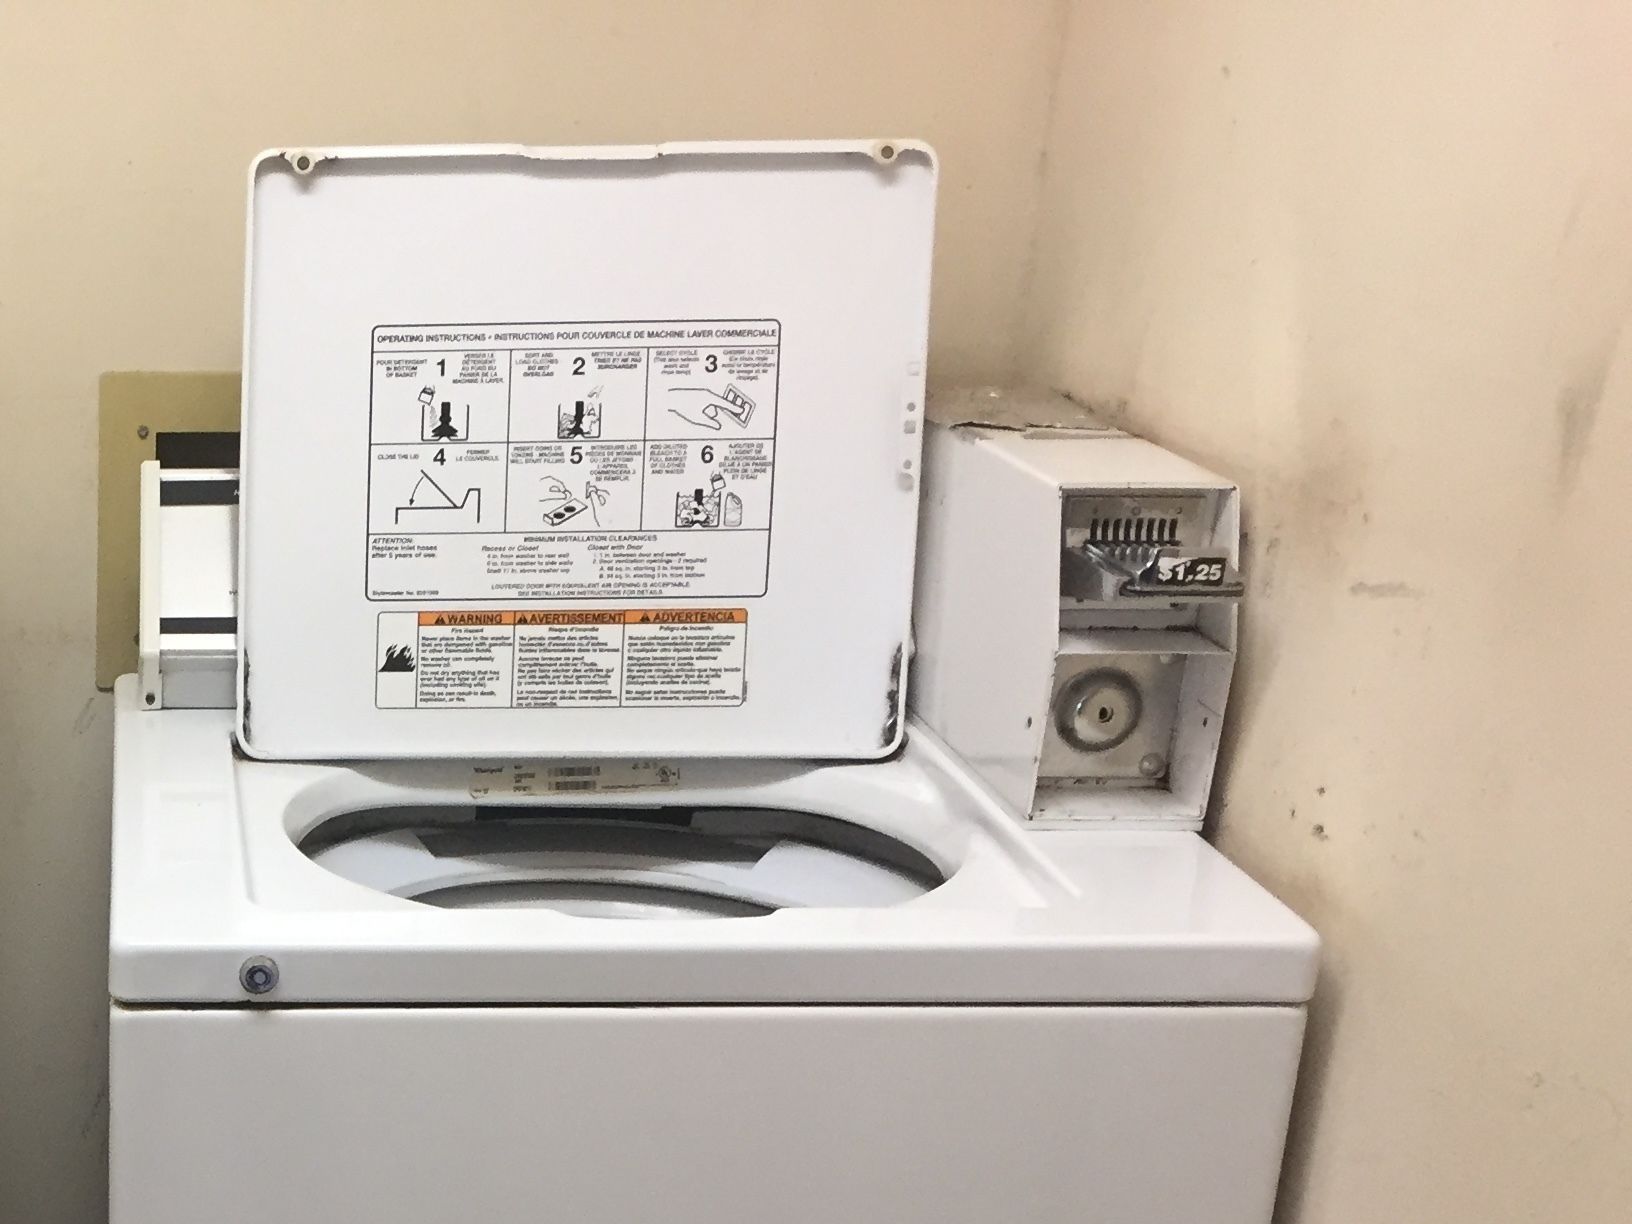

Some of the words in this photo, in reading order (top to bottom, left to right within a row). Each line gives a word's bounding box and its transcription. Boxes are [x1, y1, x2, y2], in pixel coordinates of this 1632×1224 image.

[377, 335, 423, 343] OPERATING
[425, 333, 486, 342] INSTRUCTIONS
[494, 332, 554, 341] INSTRUCTIONS
[557, 332, 579, 340] POUR
[582, 330, 632, 339] COUVERCLE
[634, 330, 645, 338] DE
[647, 330, 684, 338] MACHINE
[687, 329, 713, 338] LAVER
[715, 329, 776, 337] COMMERCIALE
[436, 358, 446, 377] 1
[572, 356, 586, 376] 2
[704, 354, 718, 373] 3
[433, 447, 446, 466] 4
[569, 446, 584, 465] 5
[700, 444, 714, 464] 6
[448, 613, 503, 624] WARNING
[529, 612, 624, 624] AVERTISSEMENT
[653, 612, 735, 621] ADVERTENCIA
